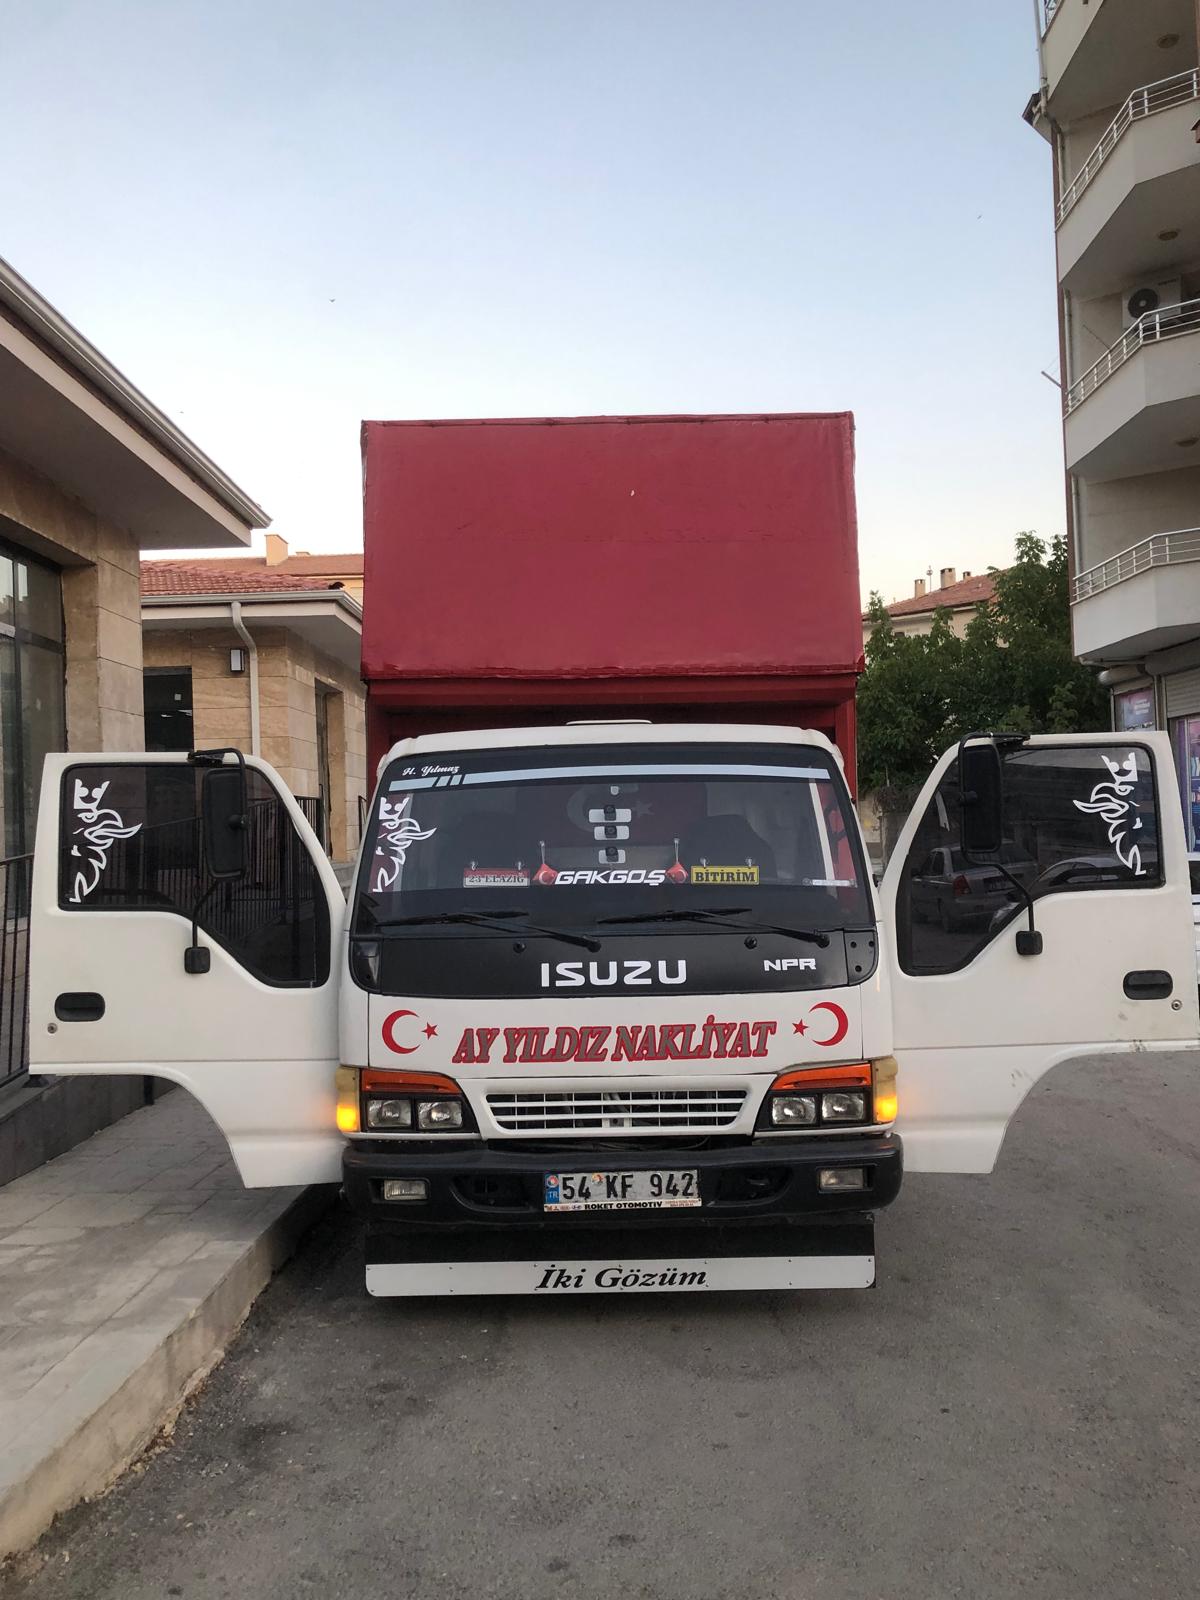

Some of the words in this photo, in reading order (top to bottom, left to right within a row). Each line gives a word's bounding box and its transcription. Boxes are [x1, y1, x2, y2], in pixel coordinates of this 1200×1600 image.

[402, 767, 416, 776] H.
[554, 869, 666, 886] GAKGOŞ
[694, 869, 755, 882] BİTİRİM
[541, 959, 687, 987] ISUZU
[763, 958, 817, 972] NPR
[452, 1027, 500, 1063] AY
[502, 1026, 612, 1063] YILDIZ
[610, 1014, 777, 1062] NAKLİYAT
[548, 1190, 559, 1199] TR
[562, 1176, 592, 1200] 54
[606, 1174, 634, 1199] KF
[650, 1172, 695, 1198] 942
[536, 1264, 586, 1289] İki
[594, 1267, 707, 1288] Gözüm
